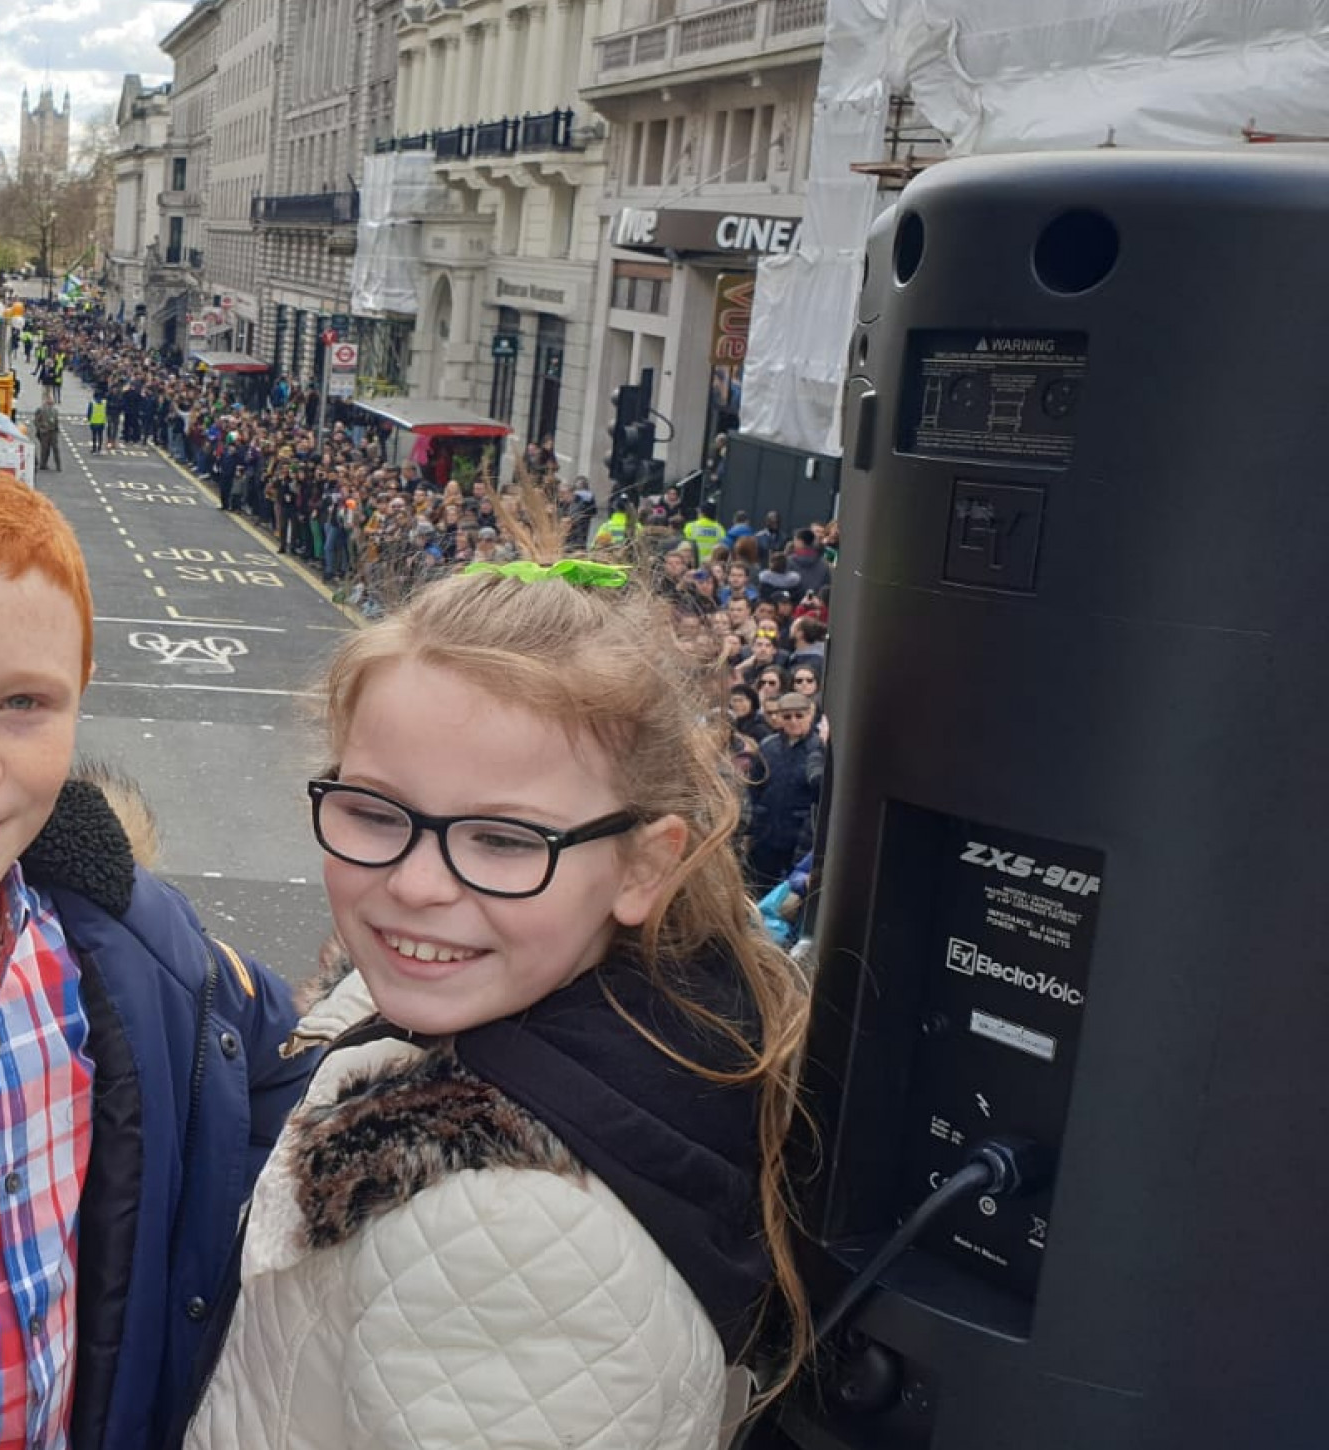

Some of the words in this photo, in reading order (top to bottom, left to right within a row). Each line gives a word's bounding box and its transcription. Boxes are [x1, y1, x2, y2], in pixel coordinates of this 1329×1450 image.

[991, 339, 1056, 353] WARNING
[122, 492, 196, 505] BUS
[152, 548, 280, 567] STOP
[174, 565, 285, 588] BUS
